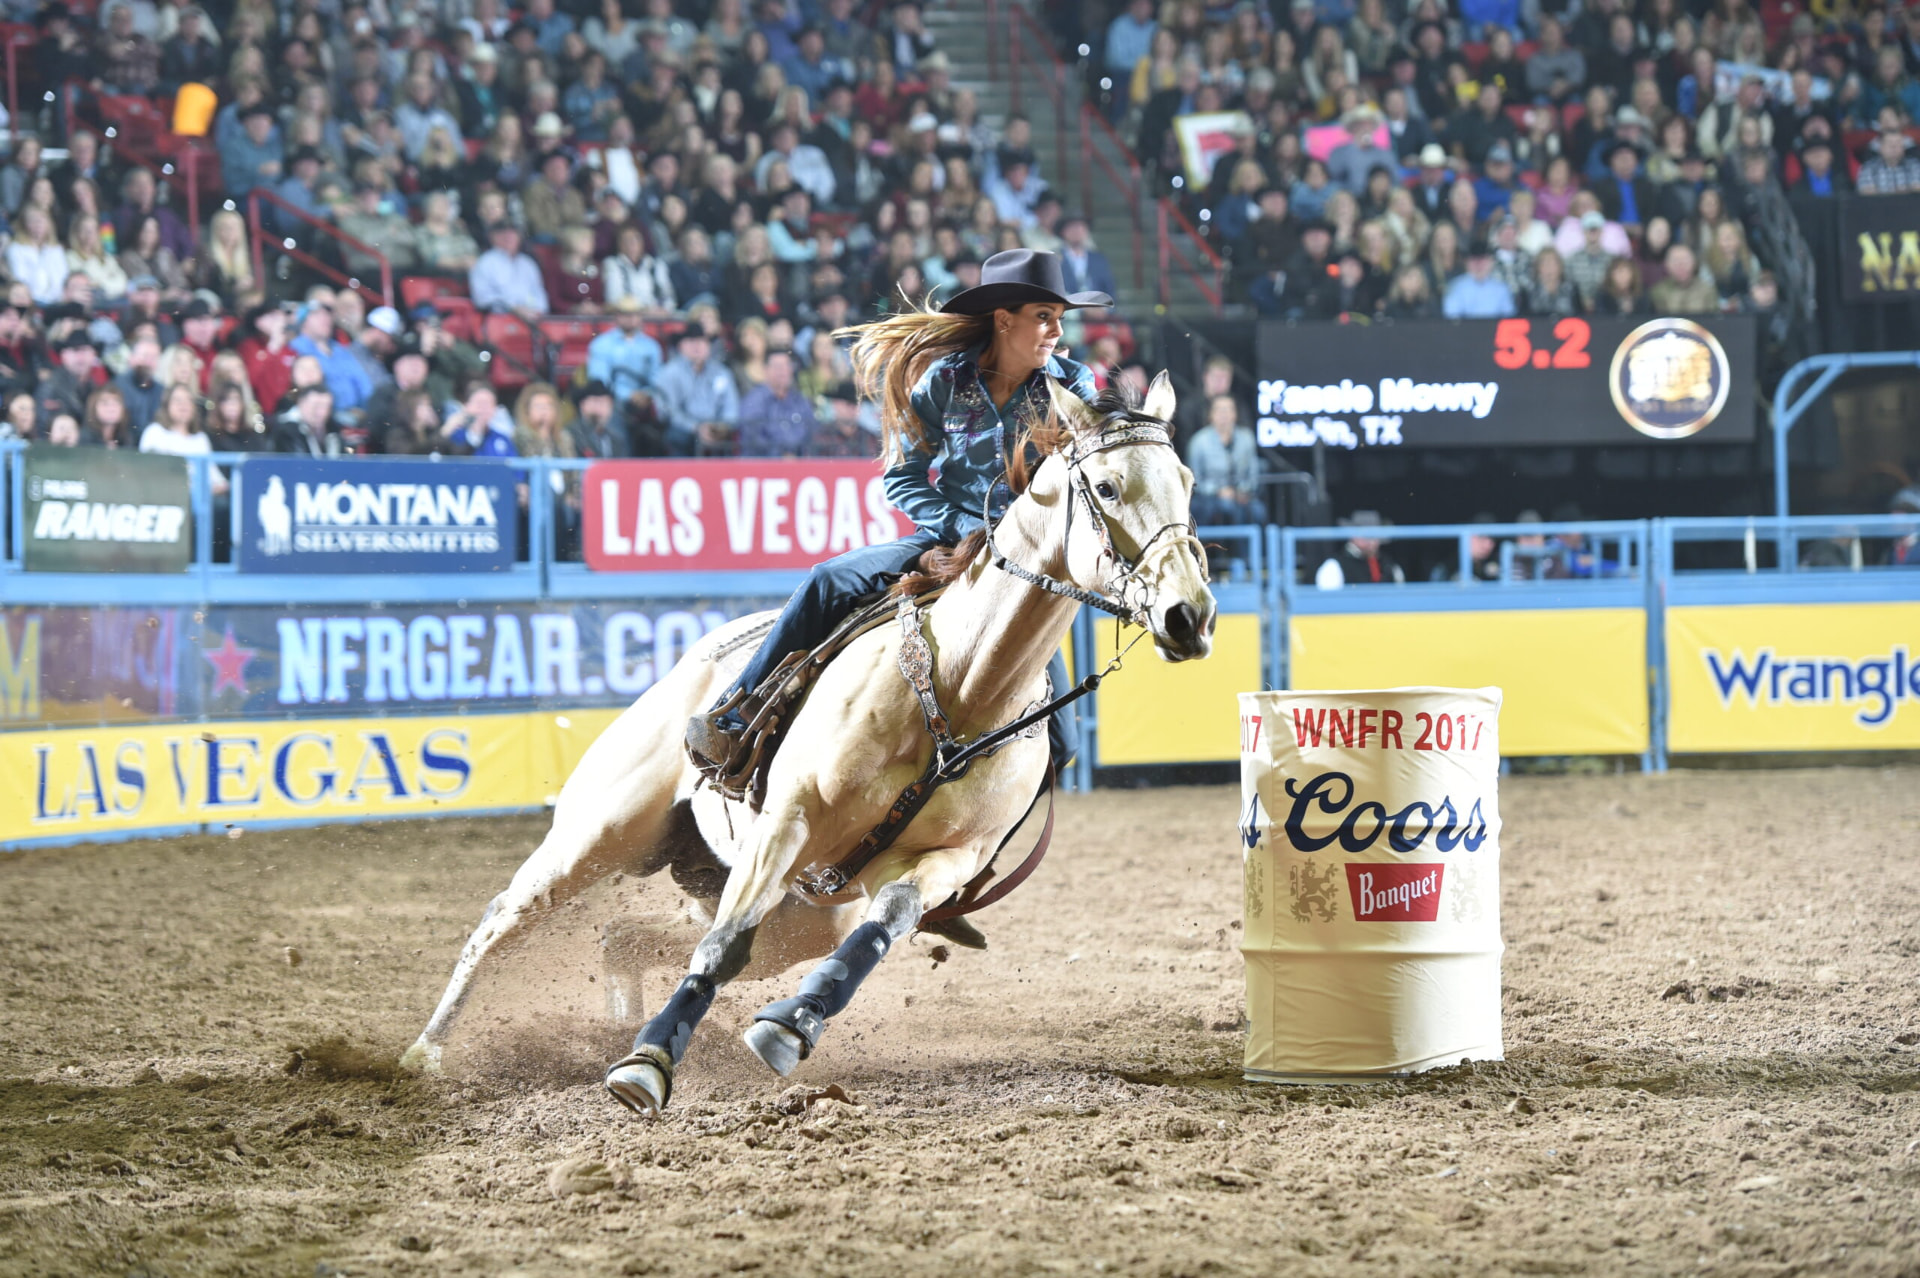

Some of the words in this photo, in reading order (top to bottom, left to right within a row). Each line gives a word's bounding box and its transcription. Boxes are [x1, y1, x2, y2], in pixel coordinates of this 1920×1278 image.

[1493, 317, 1591, 370] 5.2
[1359, 414, 1403, 446] TX
[34, 500, 185, 543] RANGER
[294, 482, 497, 526] MONTANA
[601, 476, 705, 556] LAS
[721, 476, 899, 556] VEGAS
[294, 531, 499, 553] SILVERSMITHS
[277, 610, 729, 704] NFRGEAR.CO
[1293, 708, 1403, 749] WNFR
[1413, 712, 1483, 751] 2017
[32, 740, 147, 820] LAS
[165, 729, 472, 809] VEGAS
[1284, 771, 1487, 852] Coors
[1358, 869, 1438, 915] Banquet
